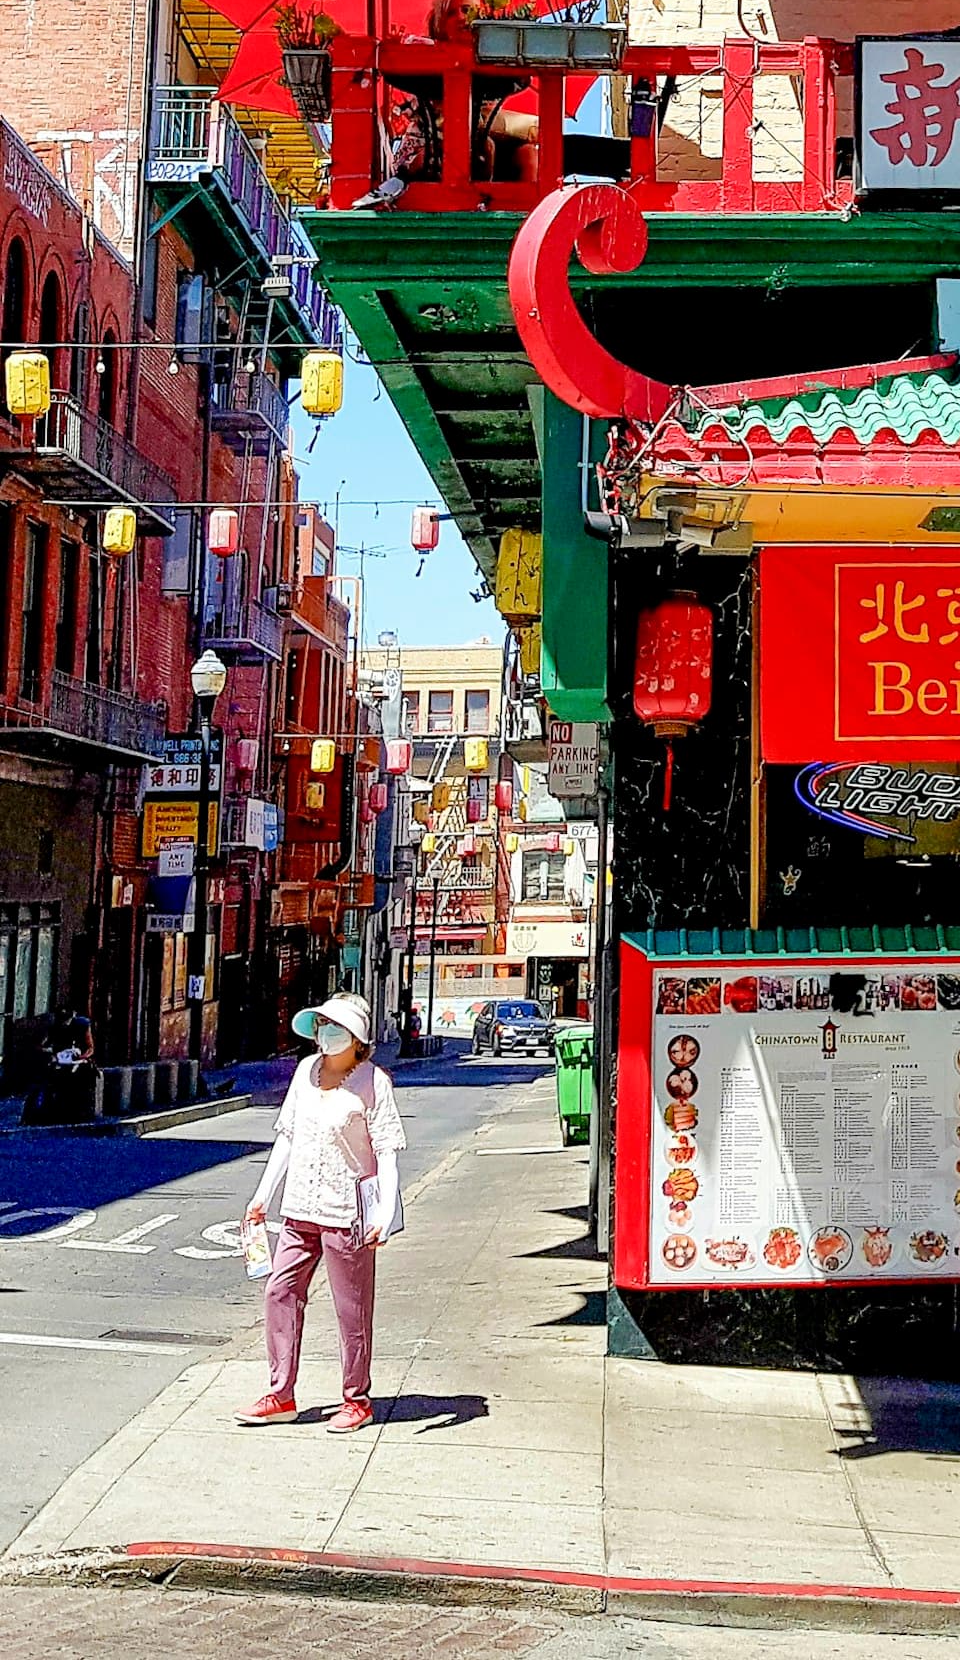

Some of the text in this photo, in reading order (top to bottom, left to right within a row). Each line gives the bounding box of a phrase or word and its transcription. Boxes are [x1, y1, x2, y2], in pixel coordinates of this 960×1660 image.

[552, 725, 570, 741] NO
[551, 747, 597, 761] PARKING
[552, 763, 594, 774] ANY TIME
[754, 1034, 906, 1046] CHINATOWN RESTAURANT
